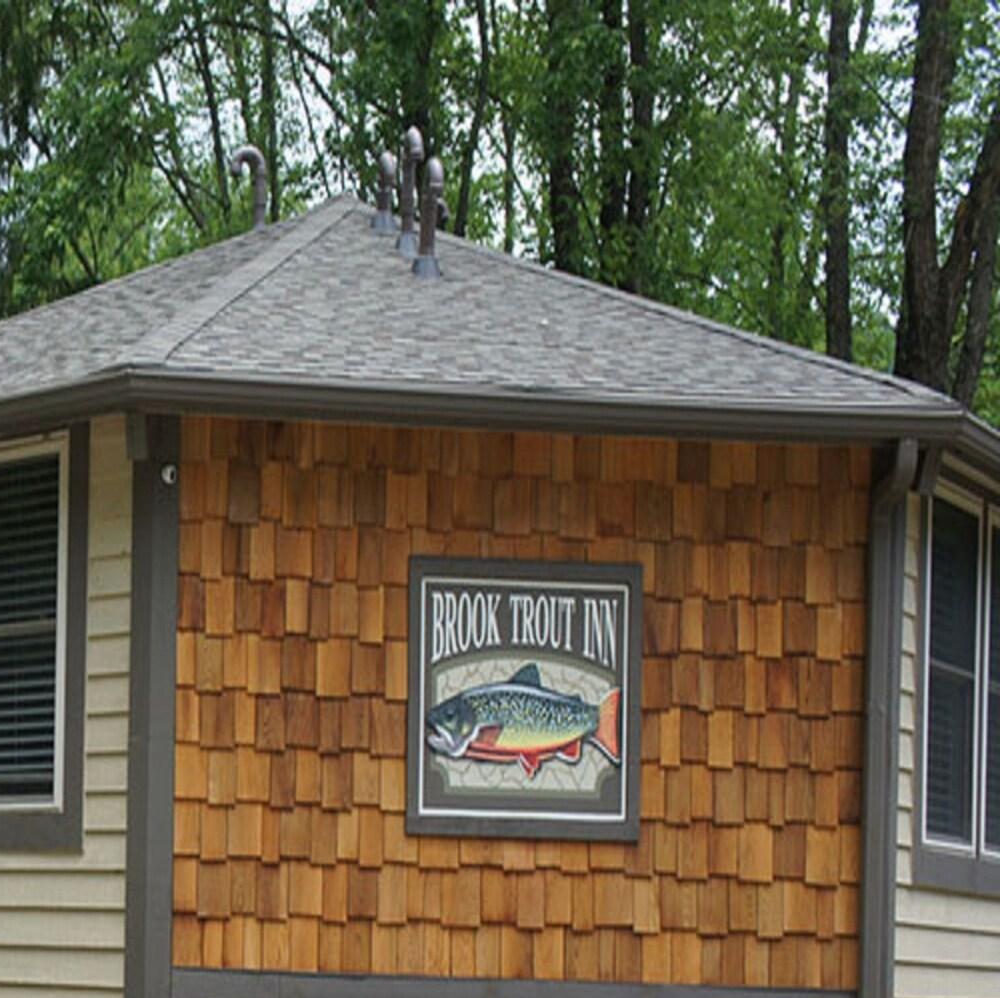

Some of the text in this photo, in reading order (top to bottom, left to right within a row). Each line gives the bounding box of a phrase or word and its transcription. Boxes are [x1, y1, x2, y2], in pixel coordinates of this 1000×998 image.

[431, 591, 618, 669] BROOK TROUT INN
